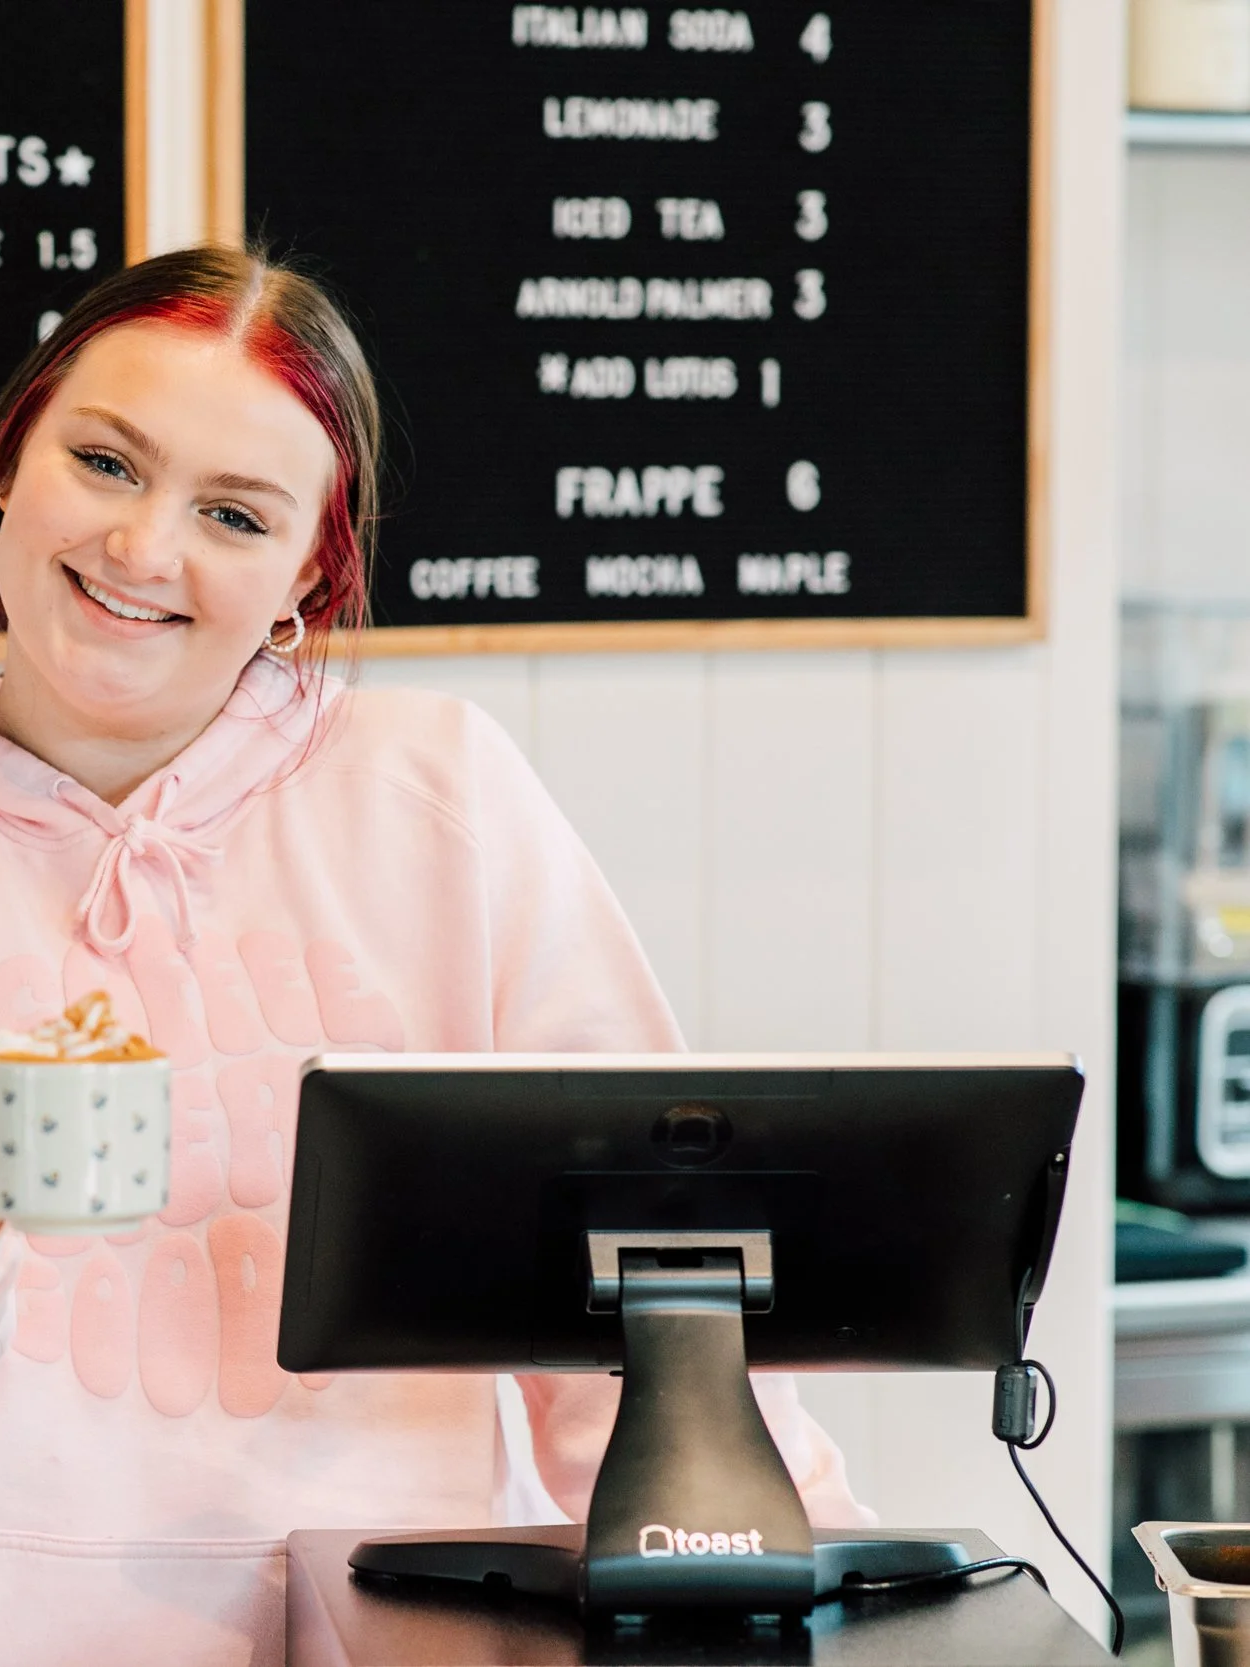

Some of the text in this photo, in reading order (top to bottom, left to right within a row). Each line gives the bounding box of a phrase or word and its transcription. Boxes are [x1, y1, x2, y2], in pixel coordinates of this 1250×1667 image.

[512, 6, 831, 61] ITALIAN SODA 4
[544, 97, 831, 152] LEMONADE 3
[553, 190, 827, 240] ICED TEA 3
[38, 228, 97, 269] 1.5
[516, 269, 826, 319] ARNOLD PALMER 3
[645, 357, 737, 398] LOTUS
[556, 461, 820, 517] FRAPPE 6
[410, 552, 849, 599] COFFEE MOCHA MAPLE
[673, 1528, 764, 1556] toast
